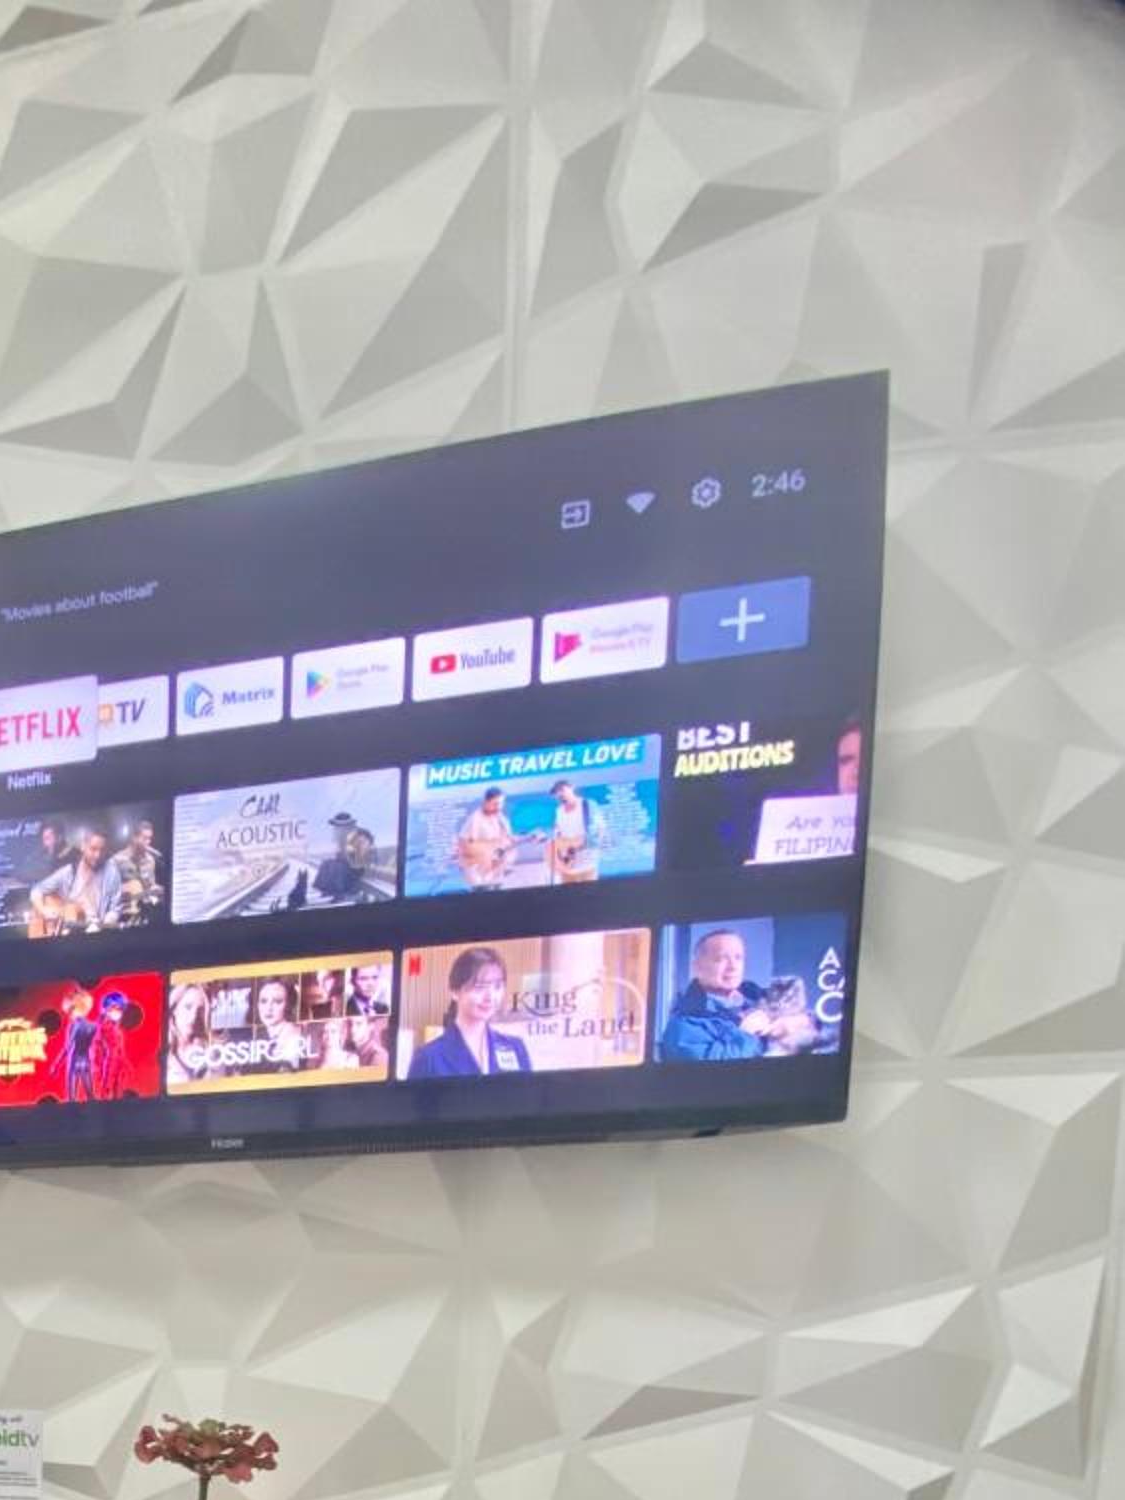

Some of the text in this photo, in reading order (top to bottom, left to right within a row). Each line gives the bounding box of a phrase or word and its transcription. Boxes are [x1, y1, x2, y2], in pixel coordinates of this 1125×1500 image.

[751, 468, 806, 497] 2:46
[55, 594, 96, 613] about
[459, 647, 517, 670] YouTube
[222, 687, 275, 705] Matrix
[115, 698, 147, 725] TV
[676, 721, 751, 751] BEST
[428, 739, 640, 786] MUSIC TRAVEL LOVE
[673, 739, 796, 777] AUDITIONS
[7, 771, 52, 791] Netflix
[216, 819, 308, 850] ACOUSTIC
[818, 946, 841, 970] A
[510, 988, 578, 1017] King
[526, 1010, 636, 1041] the Land
